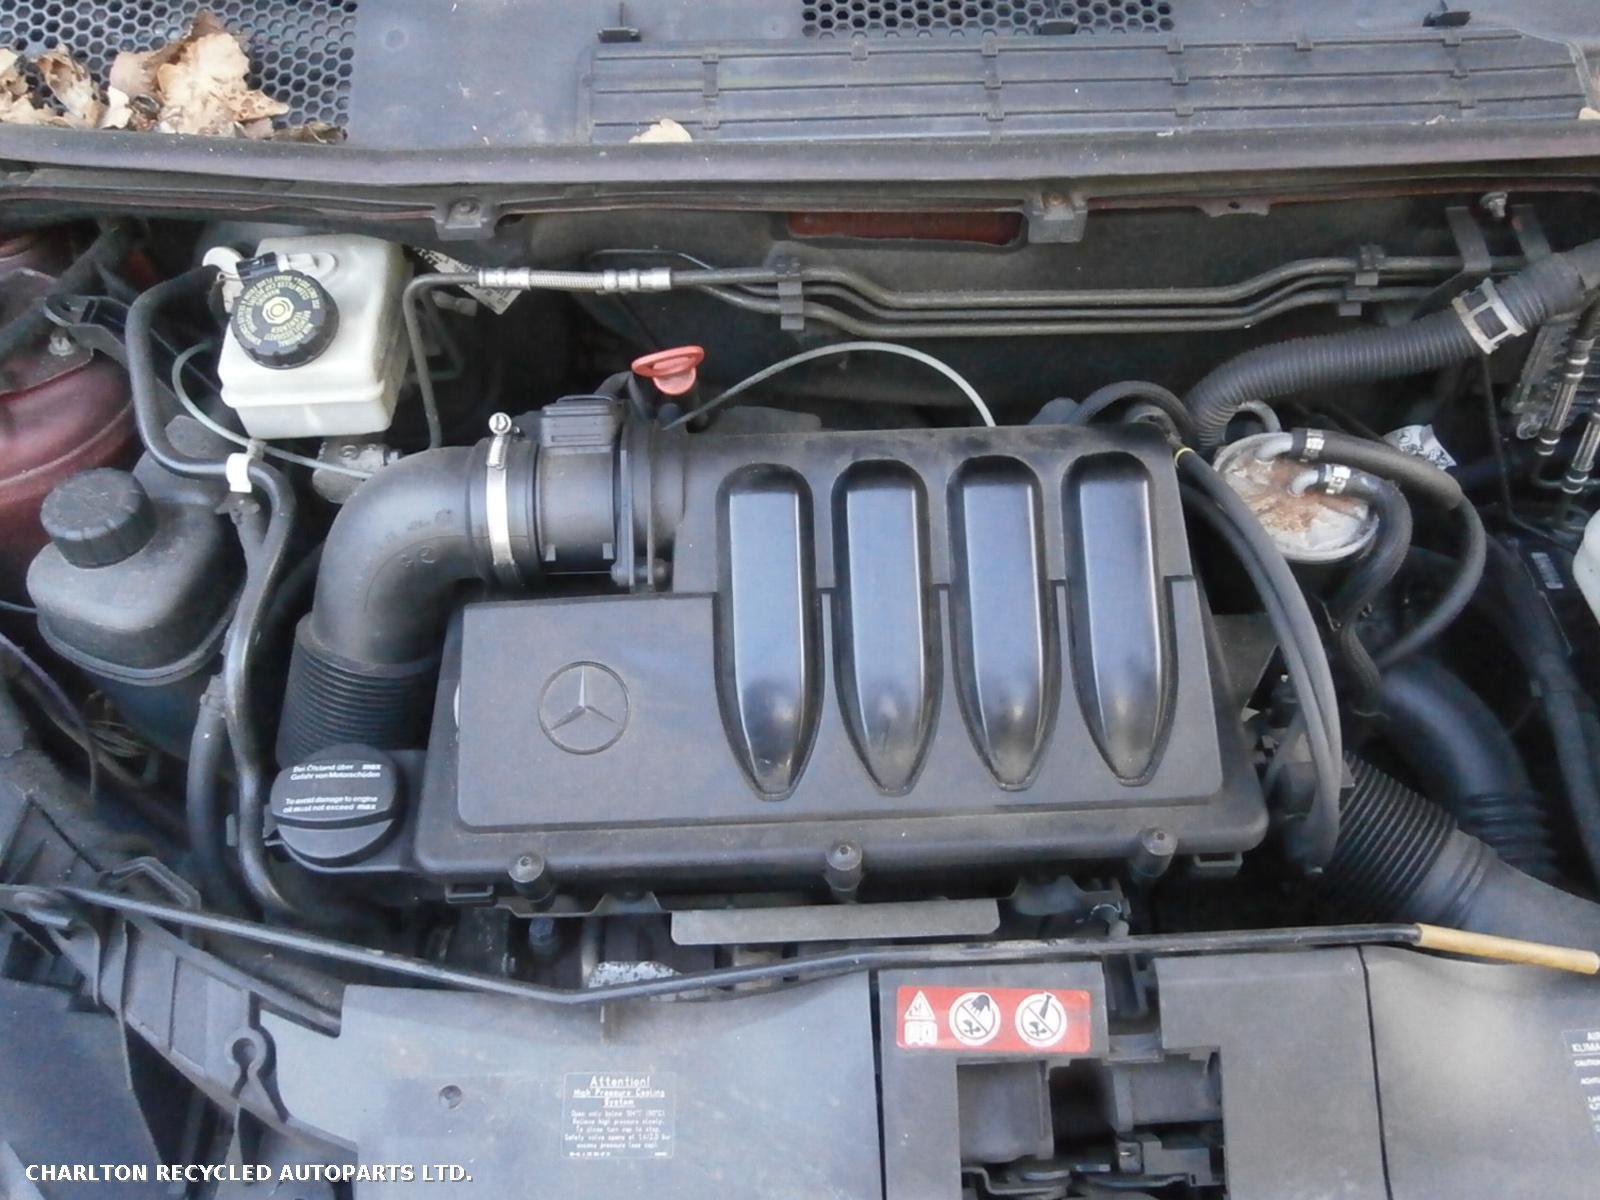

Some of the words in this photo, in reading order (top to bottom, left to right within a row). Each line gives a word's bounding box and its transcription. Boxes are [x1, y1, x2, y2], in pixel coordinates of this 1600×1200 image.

[590, 1075, 650, 1087] Attention!
[595, 1088, 632, 1097] Pressure
[636, 1088, 666, 1099] Cooling
[603, 1097, 635, 1107] System
